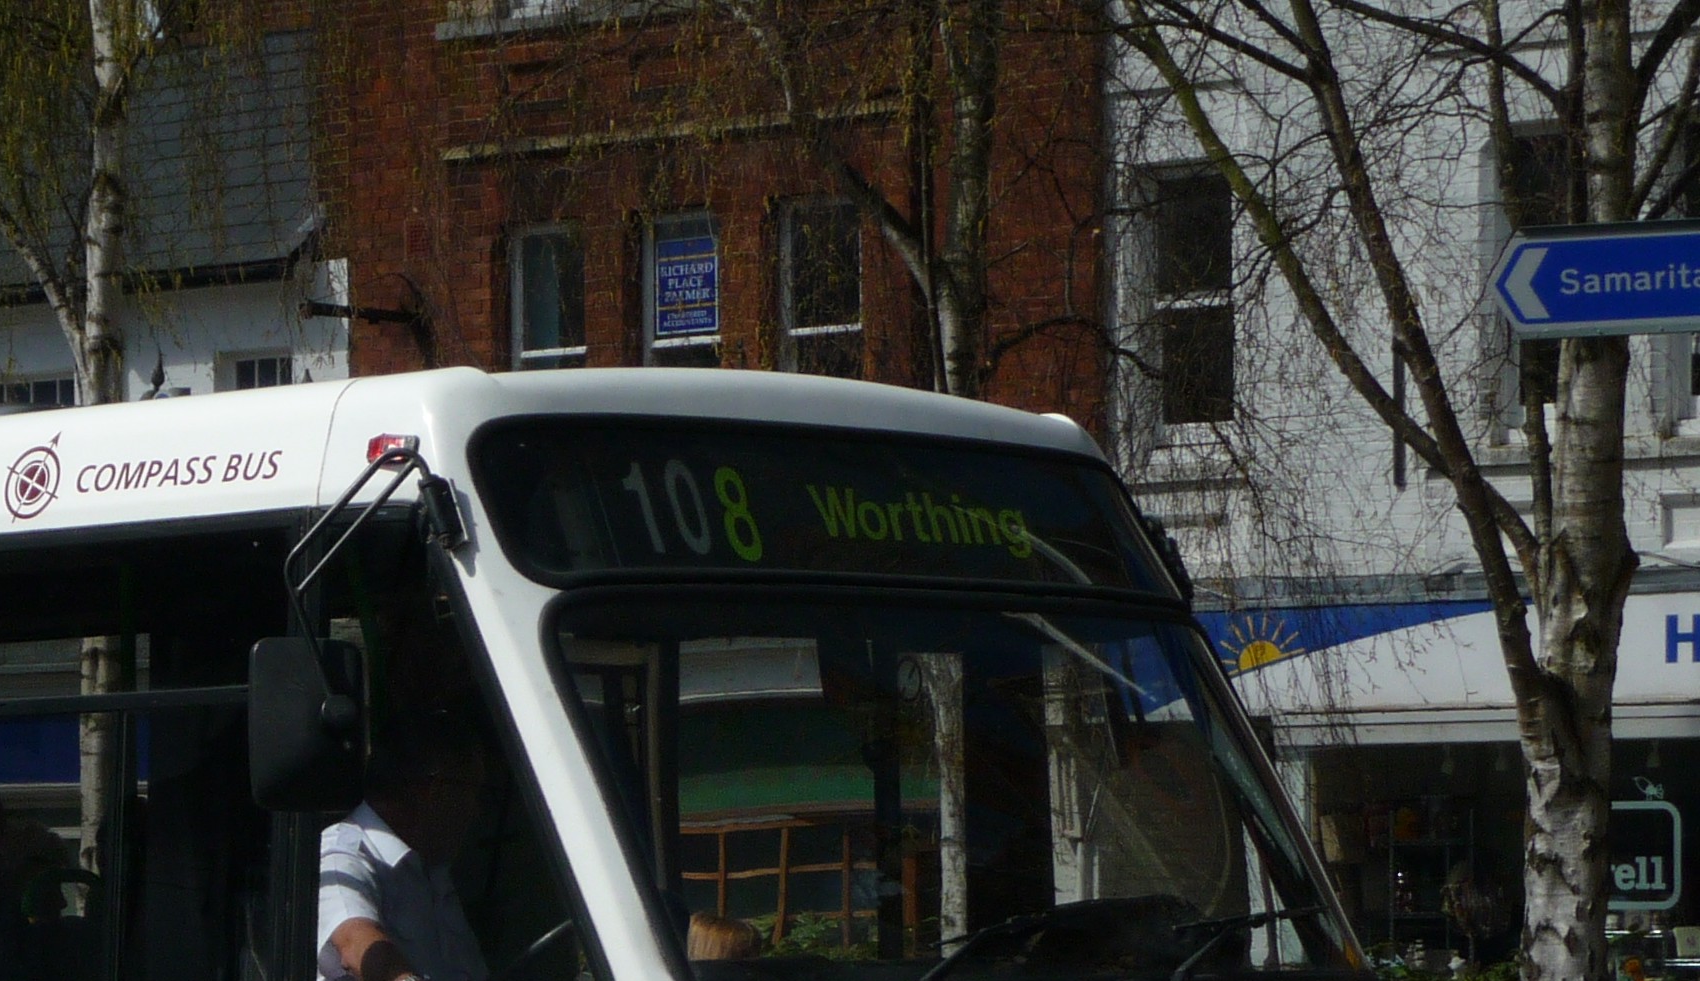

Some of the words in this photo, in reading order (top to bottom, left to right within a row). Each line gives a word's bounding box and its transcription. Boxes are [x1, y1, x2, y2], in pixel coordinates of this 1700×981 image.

[668, 276, 704, 289] PLACE
[76, 455, 217, 493] COMPASS
[222, 450, 283, 482] BUS
[622, 459, 763, 562] 108
[806, 484, 1033, 559] Worthing
[1611, 855, 1666, 891] ell
